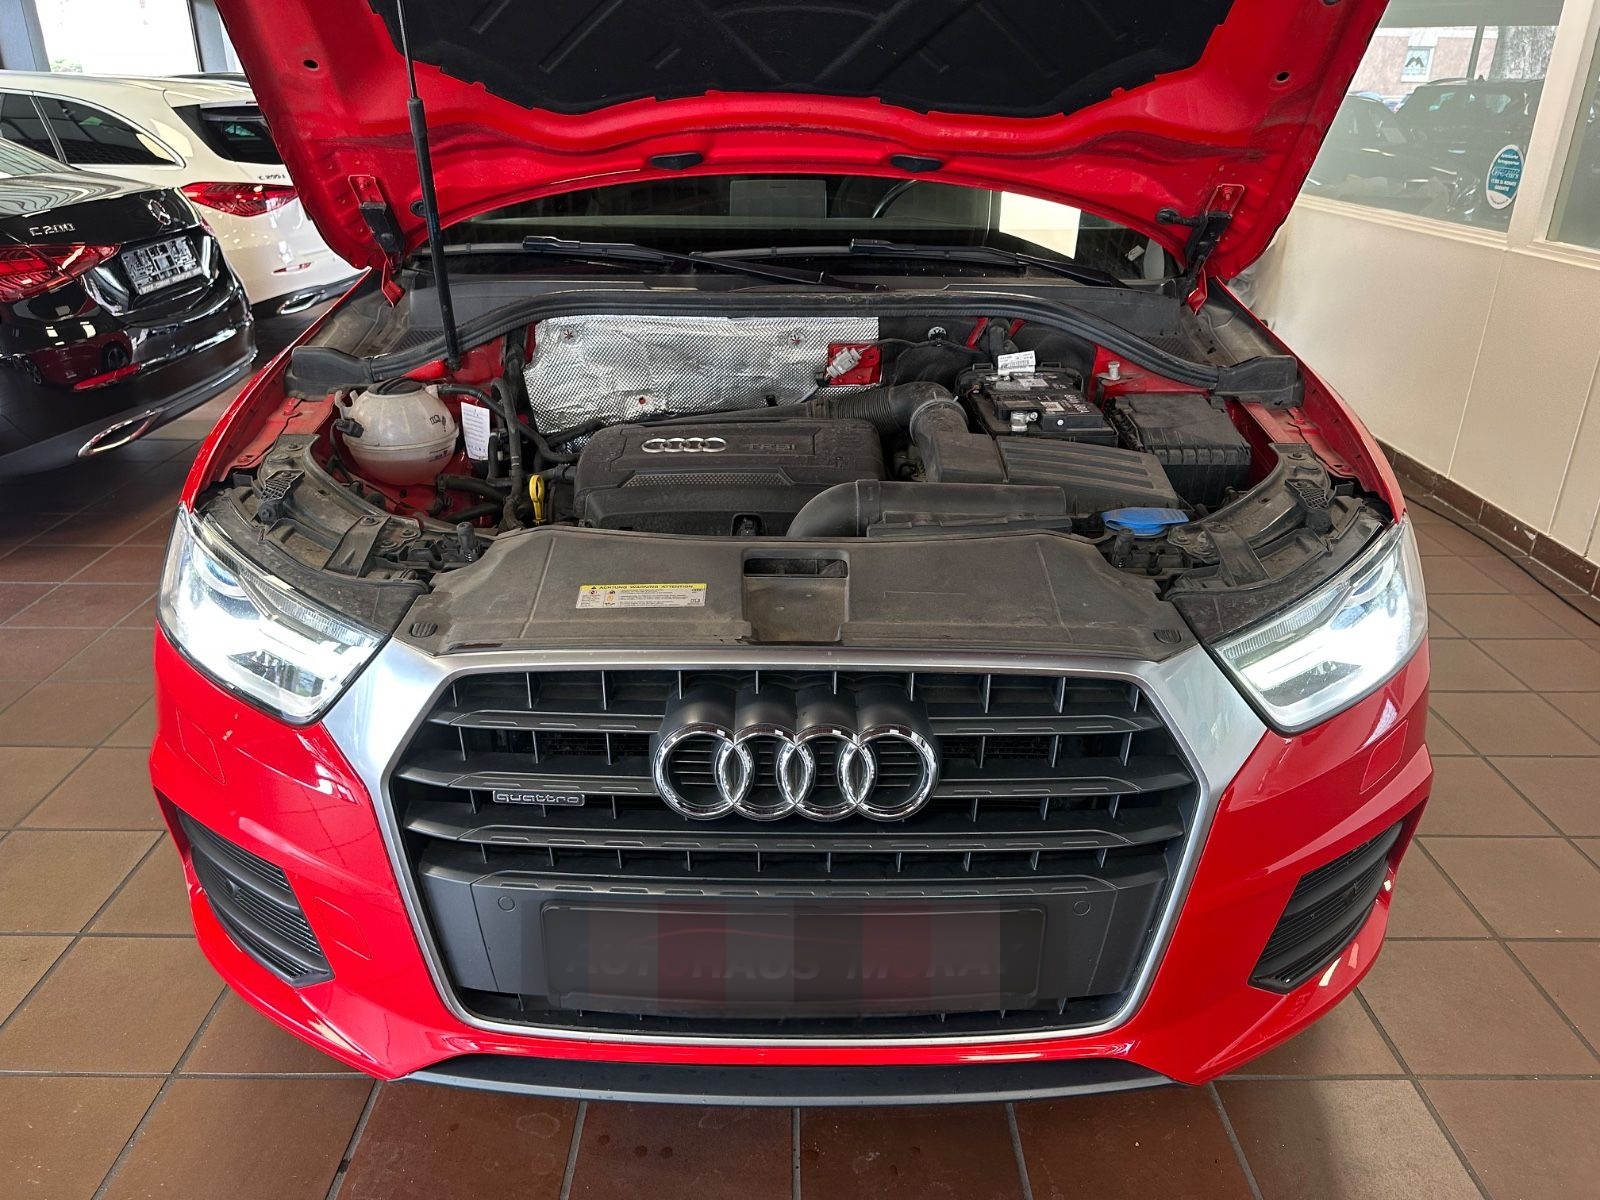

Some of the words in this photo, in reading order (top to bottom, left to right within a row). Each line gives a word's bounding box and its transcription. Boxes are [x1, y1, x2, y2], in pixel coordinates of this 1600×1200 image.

[496, 793, 580, 803] quattro
[564, 942, 821, 980] AUTOHAUS
[846, 942, 1024, 980] MORAY
